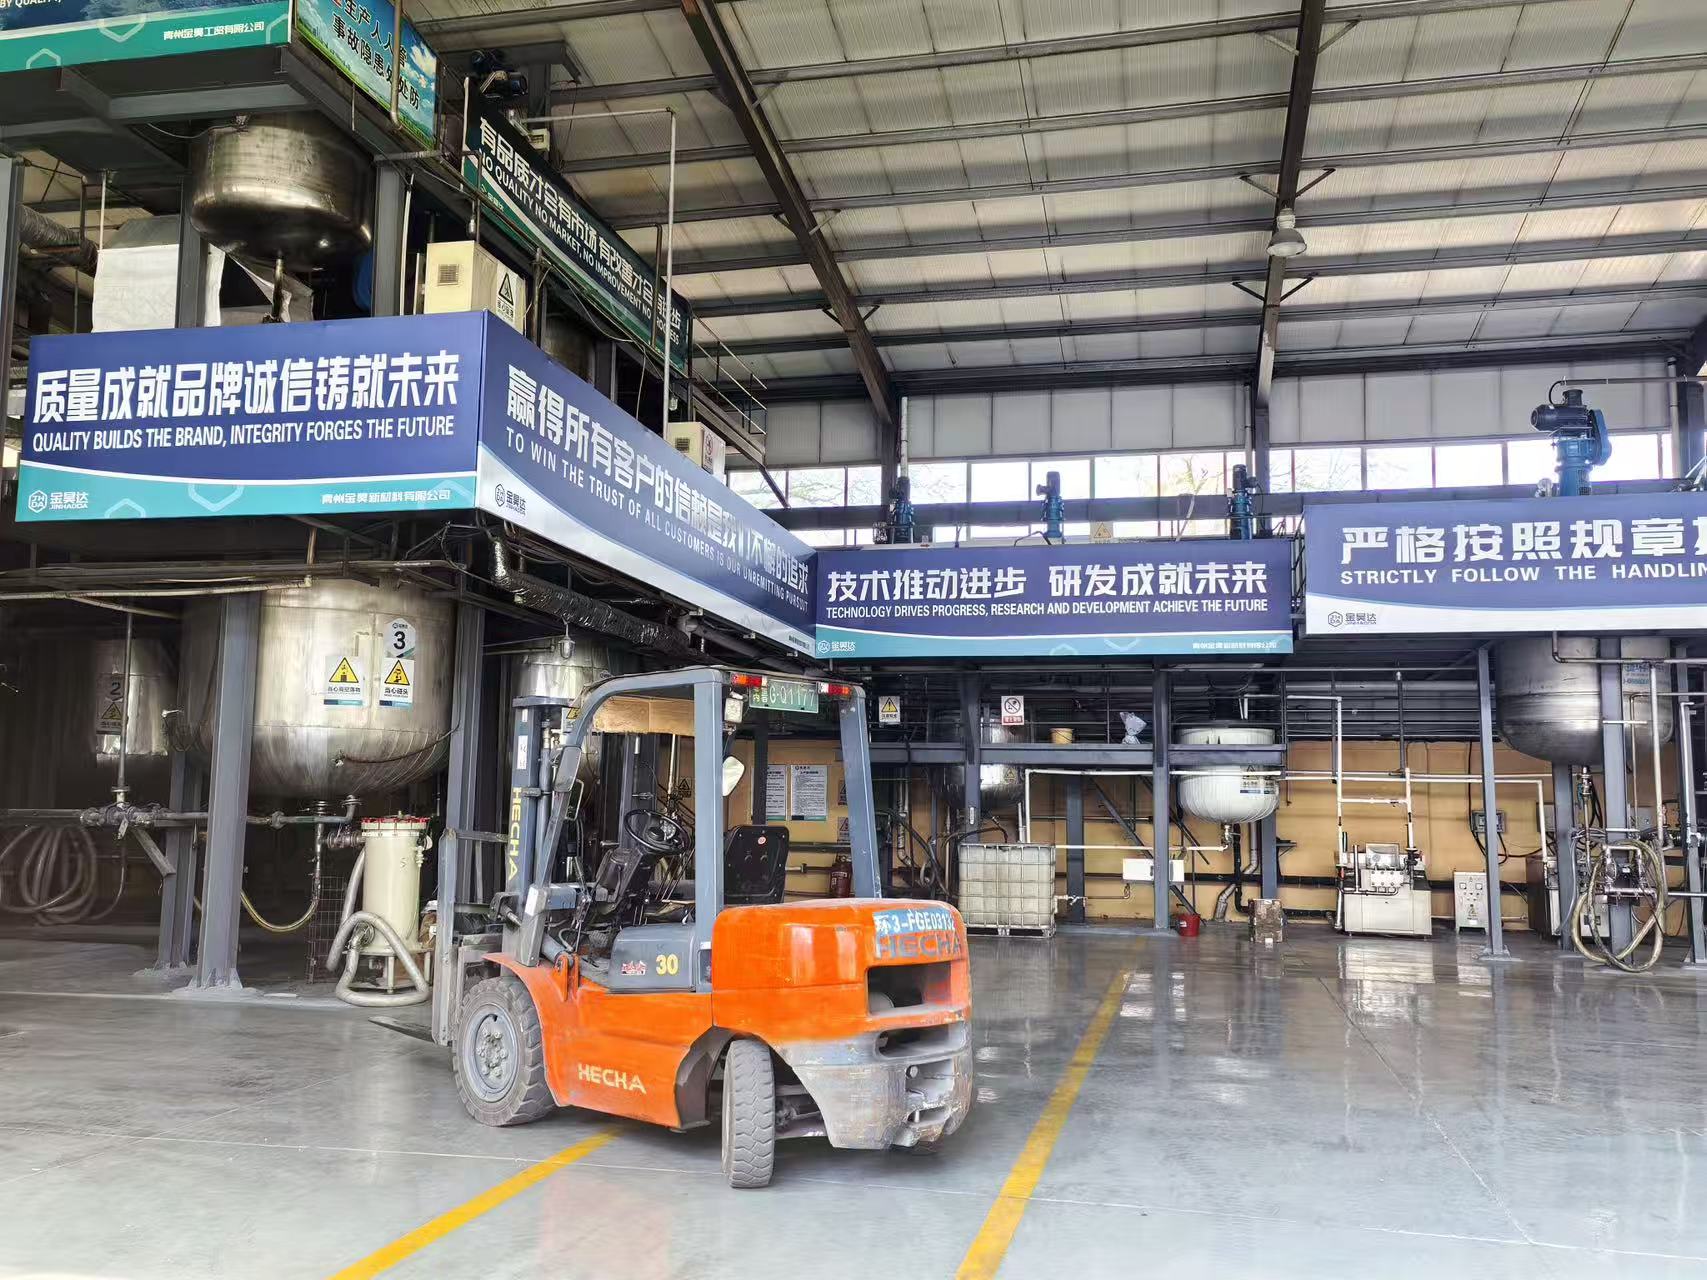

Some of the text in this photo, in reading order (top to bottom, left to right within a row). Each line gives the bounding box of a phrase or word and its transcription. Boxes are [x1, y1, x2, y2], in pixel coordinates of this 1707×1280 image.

[480, 116, 597, 254] 有品质才会有市场
[495, 166, 534, 209] QUALITY
[535, 203, 548, 223] NO
[549, 216, 582, 258] MARKET,
[583, 248, 594, 267] NO
[595, 260, 641, 310] IMPROVEMENT
[642, 303, 652, 320] NO
[33, 350, 459, 423] 质量成就品牌诚信铸就未来
[33, 415, 454, 452] QUALITY BUILDS THE BRAND, INTEGRITY FORGES THE FUTURE
[507, 364, 808, 594] 赢得所有客户的信赖是我们不懈的追求
[506, 426, 524, 453] TO
[531, 441, 556, 472] WIN
[562, 459, 584, 488] THE
[589, 475, 624, 510] TRUST
[629, 499, 641, 519] OF
[645, 509, 661, 531] ALL
[665, 521, 714, 560] CUSTOMERS
[717, 550, 724, 567] IS
[726, 555, 740, 577] OUR
[743, 566, 784, 600] UNREMITTING
[1341, 516, 1707, 565] 严格按照规章
[827, 561, 1267, 602] 技术推动进步 研发成就未来
[1340, 562, 1707, 585] STRICTLY FOLLOW THE HANDLIN
[826, 599, 1268, 619] TECHNOLOGY DRIVES PROGRESS, RESEARCH AND DEVELOPMENT ACHIEVE THE FUTURE
[393, 631, 406, 649] 3
[110, 681, 121, 695] 2
[508, 787, 522, 881] HECHA
[656, 953, 679, 976] 30
[875, 931, 961, 959] HECHA
[577, 1062, 647, 1094] HECHA
